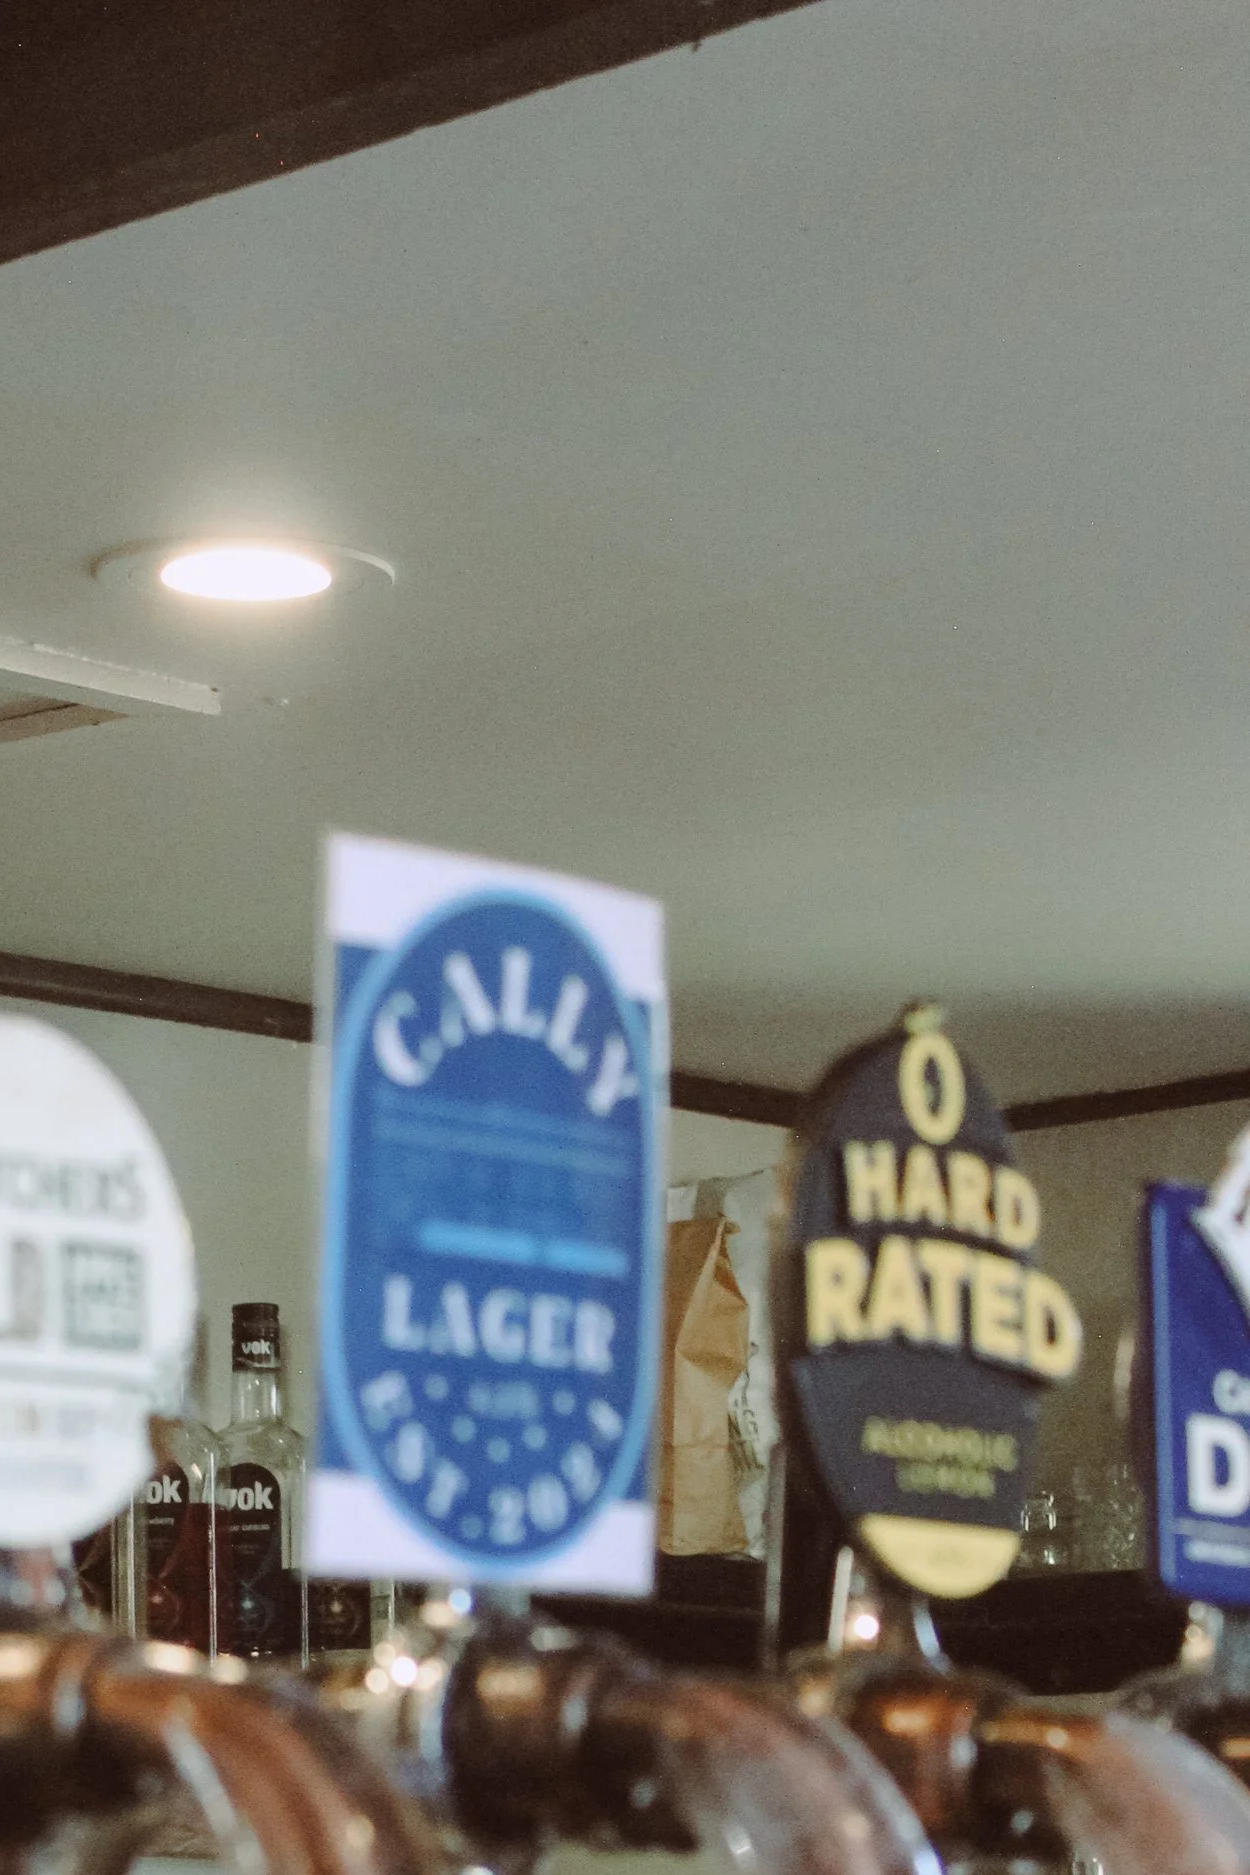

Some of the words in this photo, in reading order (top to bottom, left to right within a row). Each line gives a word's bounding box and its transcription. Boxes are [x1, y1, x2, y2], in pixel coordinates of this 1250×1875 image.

[844, 1139, 1041, 1252] HARD
[382, 1272, 617, 1375] LAGER
[803, 1235, 1084, 1381] RATED
[145, 1474, 182, 1505] ok
